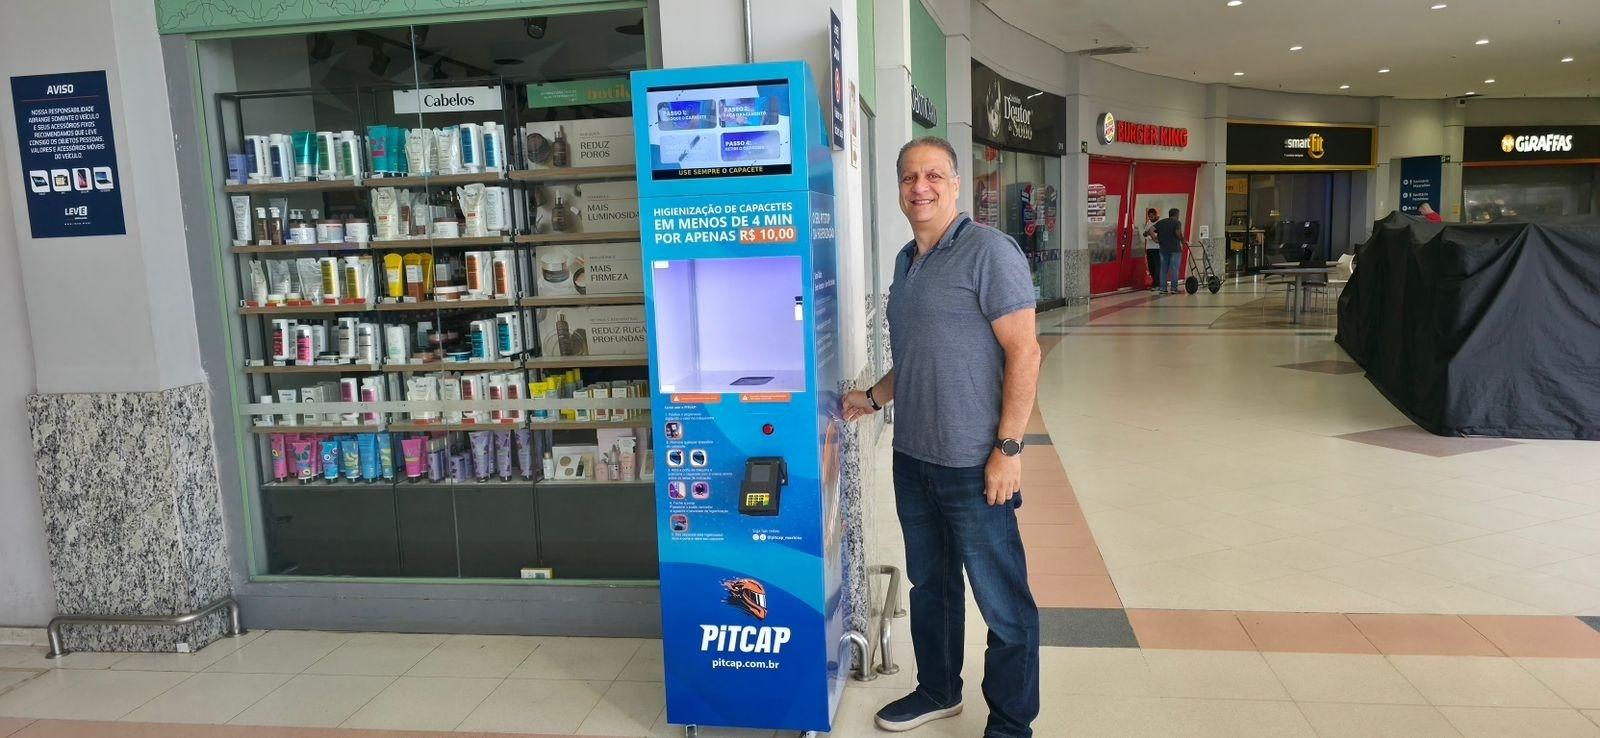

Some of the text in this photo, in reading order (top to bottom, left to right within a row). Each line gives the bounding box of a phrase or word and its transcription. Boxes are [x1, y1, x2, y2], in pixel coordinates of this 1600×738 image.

[47, 84, 74, 95] AVISO
[424, 93, 475, 107] Cabelos
[49, 106, 94, 114] RESPONSABILIDADE
[51, 122, 80, 130] ACESSÓRIOS
[1117, 120, 1158, 145] BURGER
[1160, 126, 1188, 147] KING
[580, 141, 609, 149] REDUZ
[580, 151, 611, 159] POROS
[588, 204, 609, 212] MAIS
[654, 202, 792, 217] HIGIENIZAÇÃO DE CAPACETES
[655, 214, 792, 230] EM MENOS DE 4 MIN
[655, 228, 794, 244] POR APENAS R$ 10,00
[593, 335, 645, 343] PROFUNDAS
[712, 658, 779, 669] pitcap.com.br
